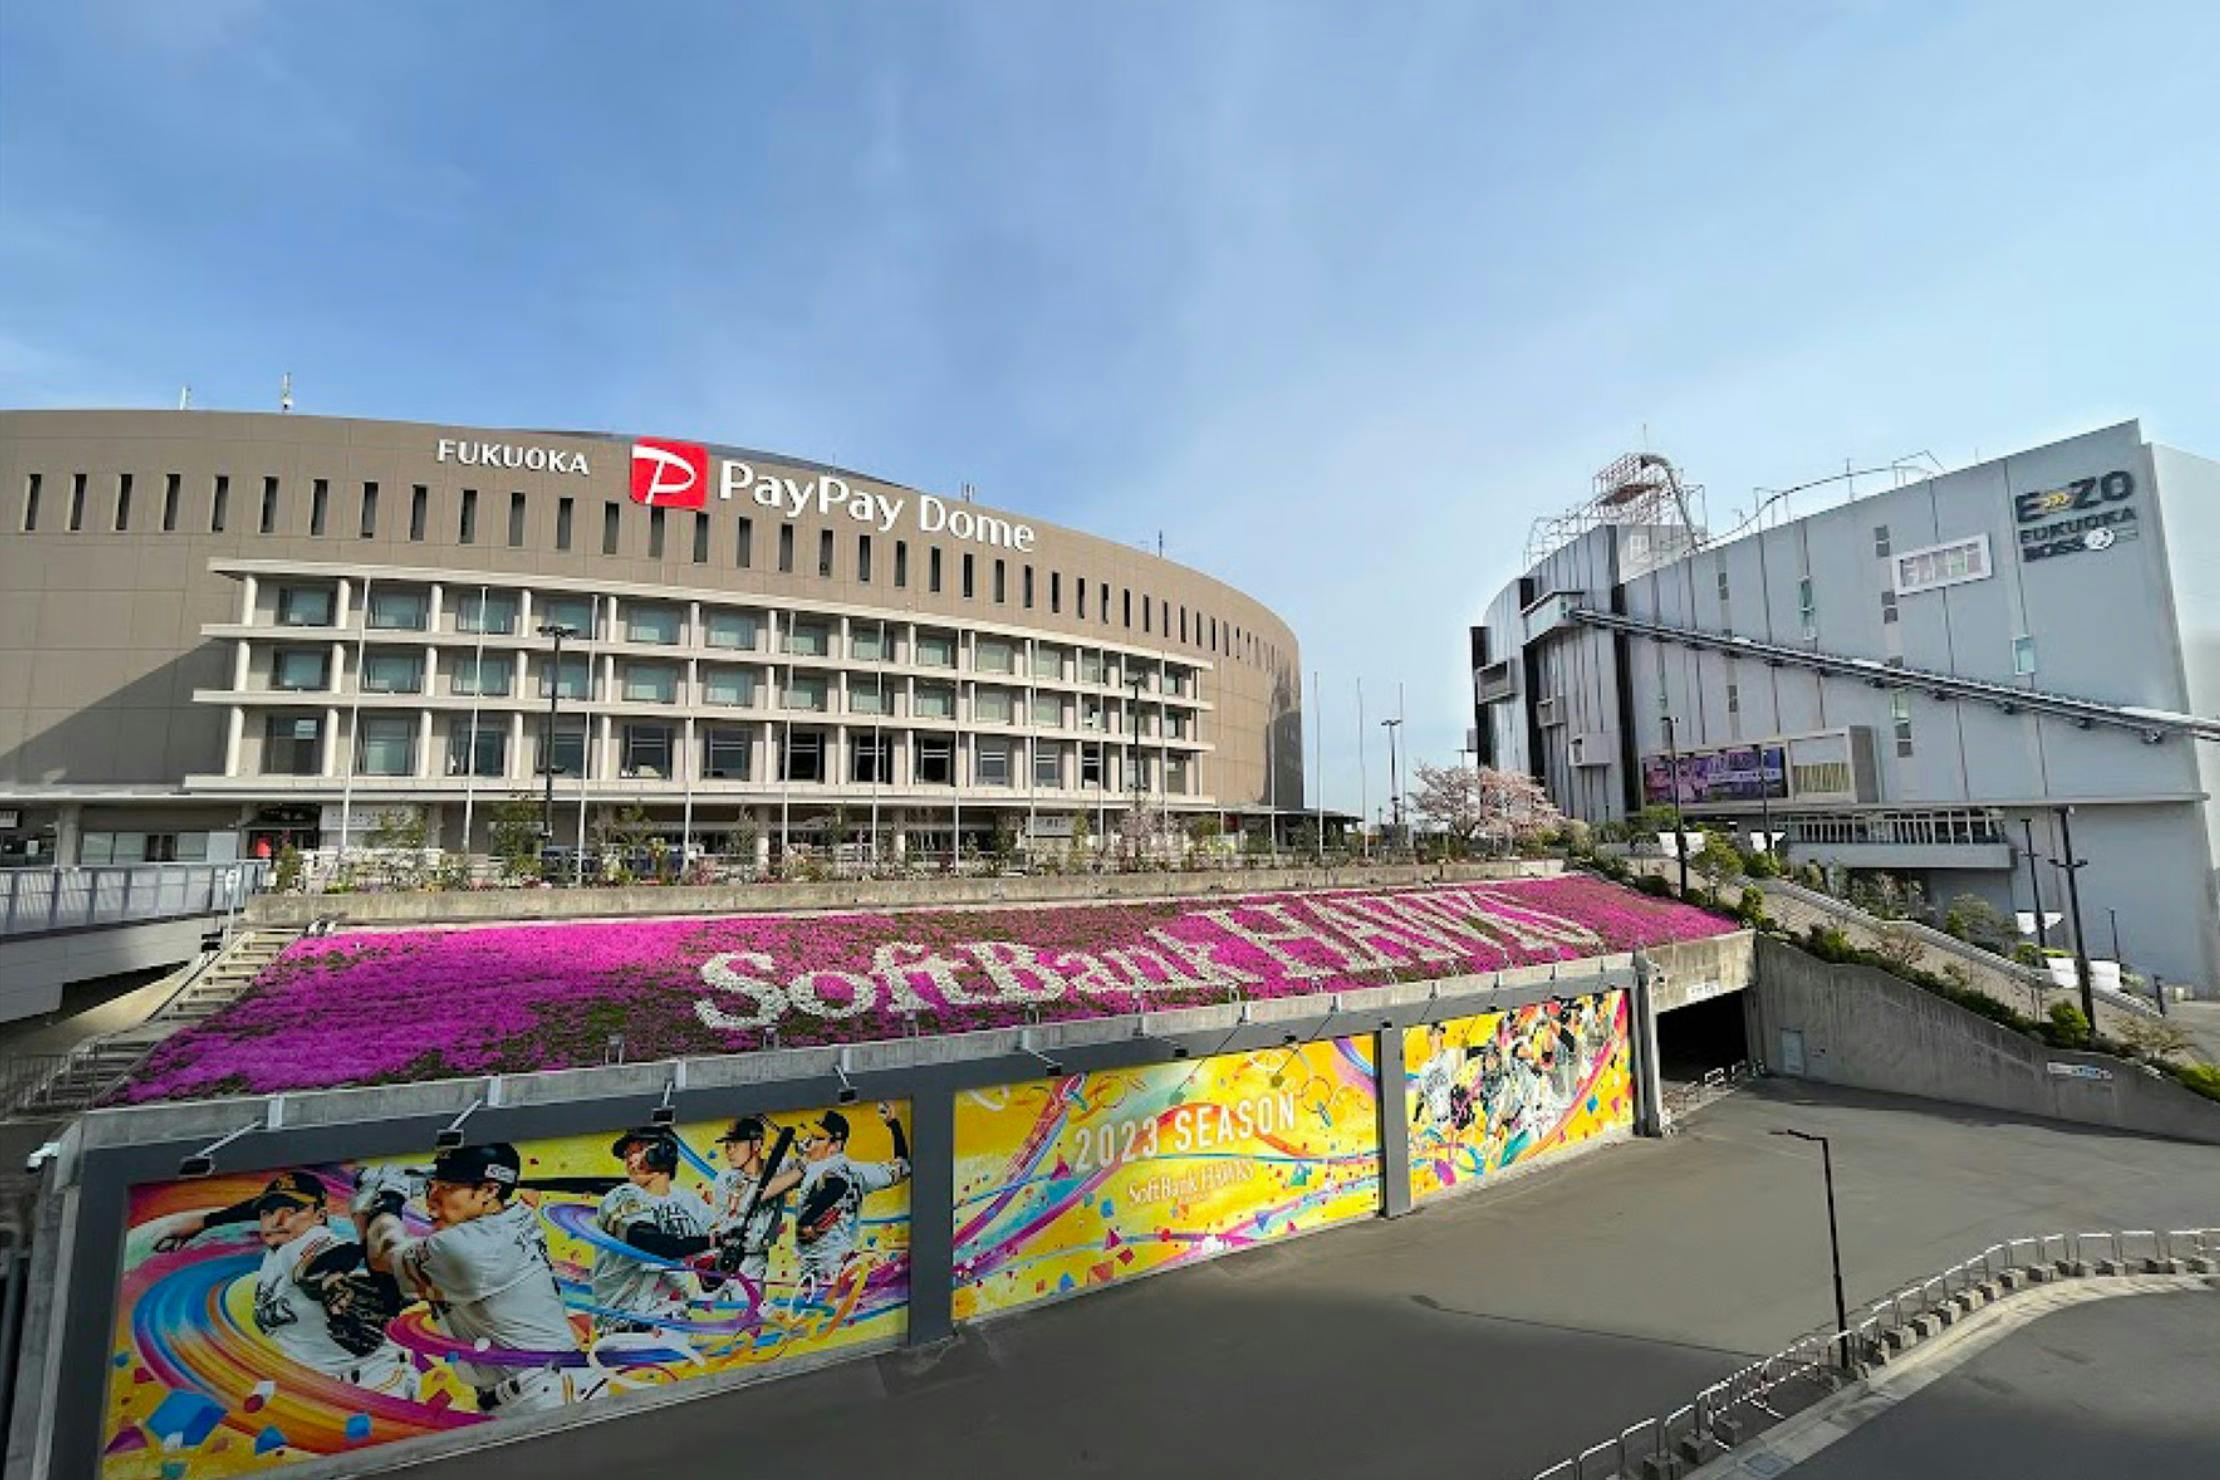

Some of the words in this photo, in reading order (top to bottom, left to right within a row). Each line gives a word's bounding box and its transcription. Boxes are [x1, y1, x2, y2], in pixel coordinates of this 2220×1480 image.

[437, 438, 590, 476] FUKUOKA
[718, 459, 904, 532] PayPay
[918, 493, 1037, 554] Dome
[2020, 506, 2139, 545] FUKUOKA
[694, 926, 1265, 1030] SoftBank
[1074, 1115, 1160, 1174] 2023
[1174, 1090, 1297, 1153] SEASON
